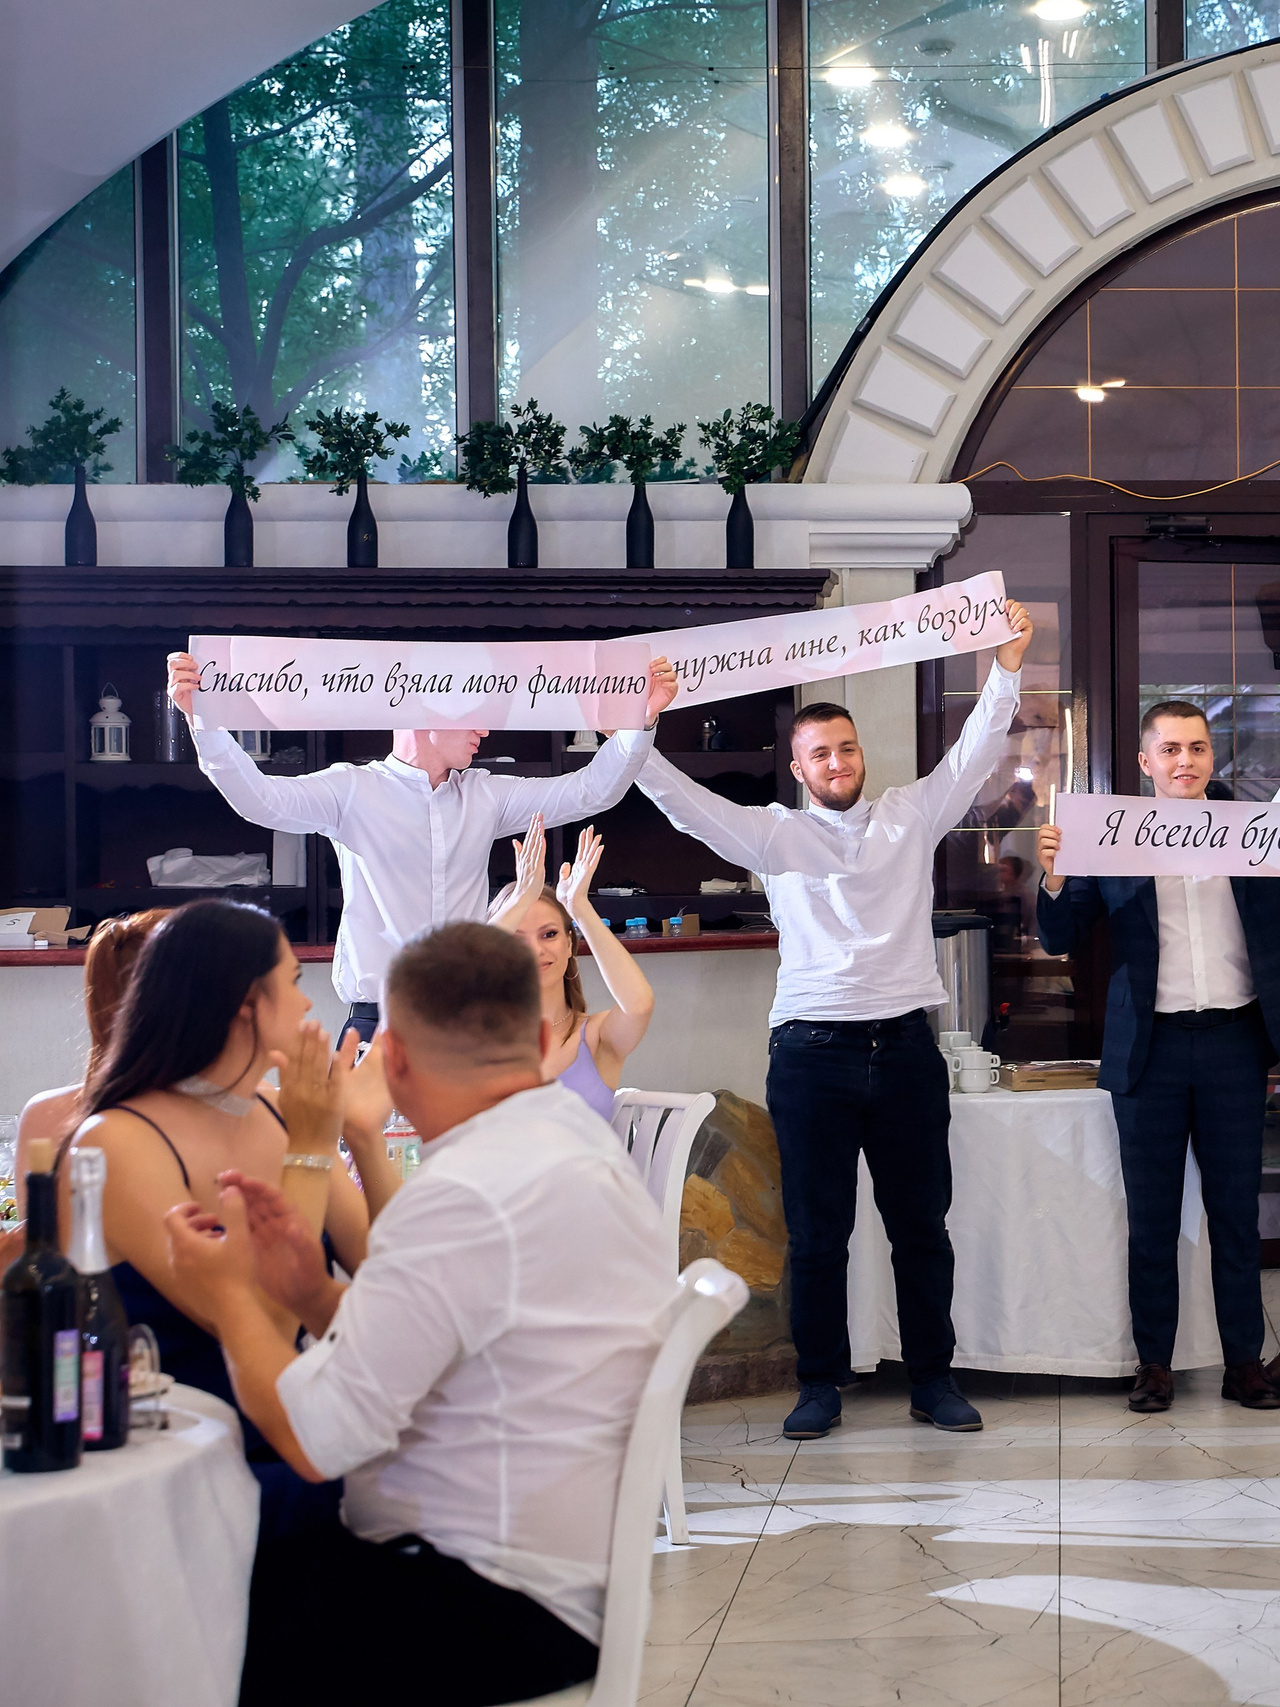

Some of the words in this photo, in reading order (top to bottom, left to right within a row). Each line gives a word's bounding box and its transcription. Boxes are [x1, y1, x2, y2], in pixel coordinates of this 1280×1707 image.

[672, 646, 774, 693] нужна
[785, 634, 847, 658] мне,
[858, 620, 906, 647] как
[917, 595, 1006, 642] воздух
[198, 659, 309, 701] Спасибо,
[321, 663, 374, 693] что
[384, 661, 453, 707] взяла
[462, 673, 519, 694] мою
[528, 664, 647, 709] фамилию
[1098, 809, 1126, 846] Я
[1134, 809, 1230, 849] всегда
